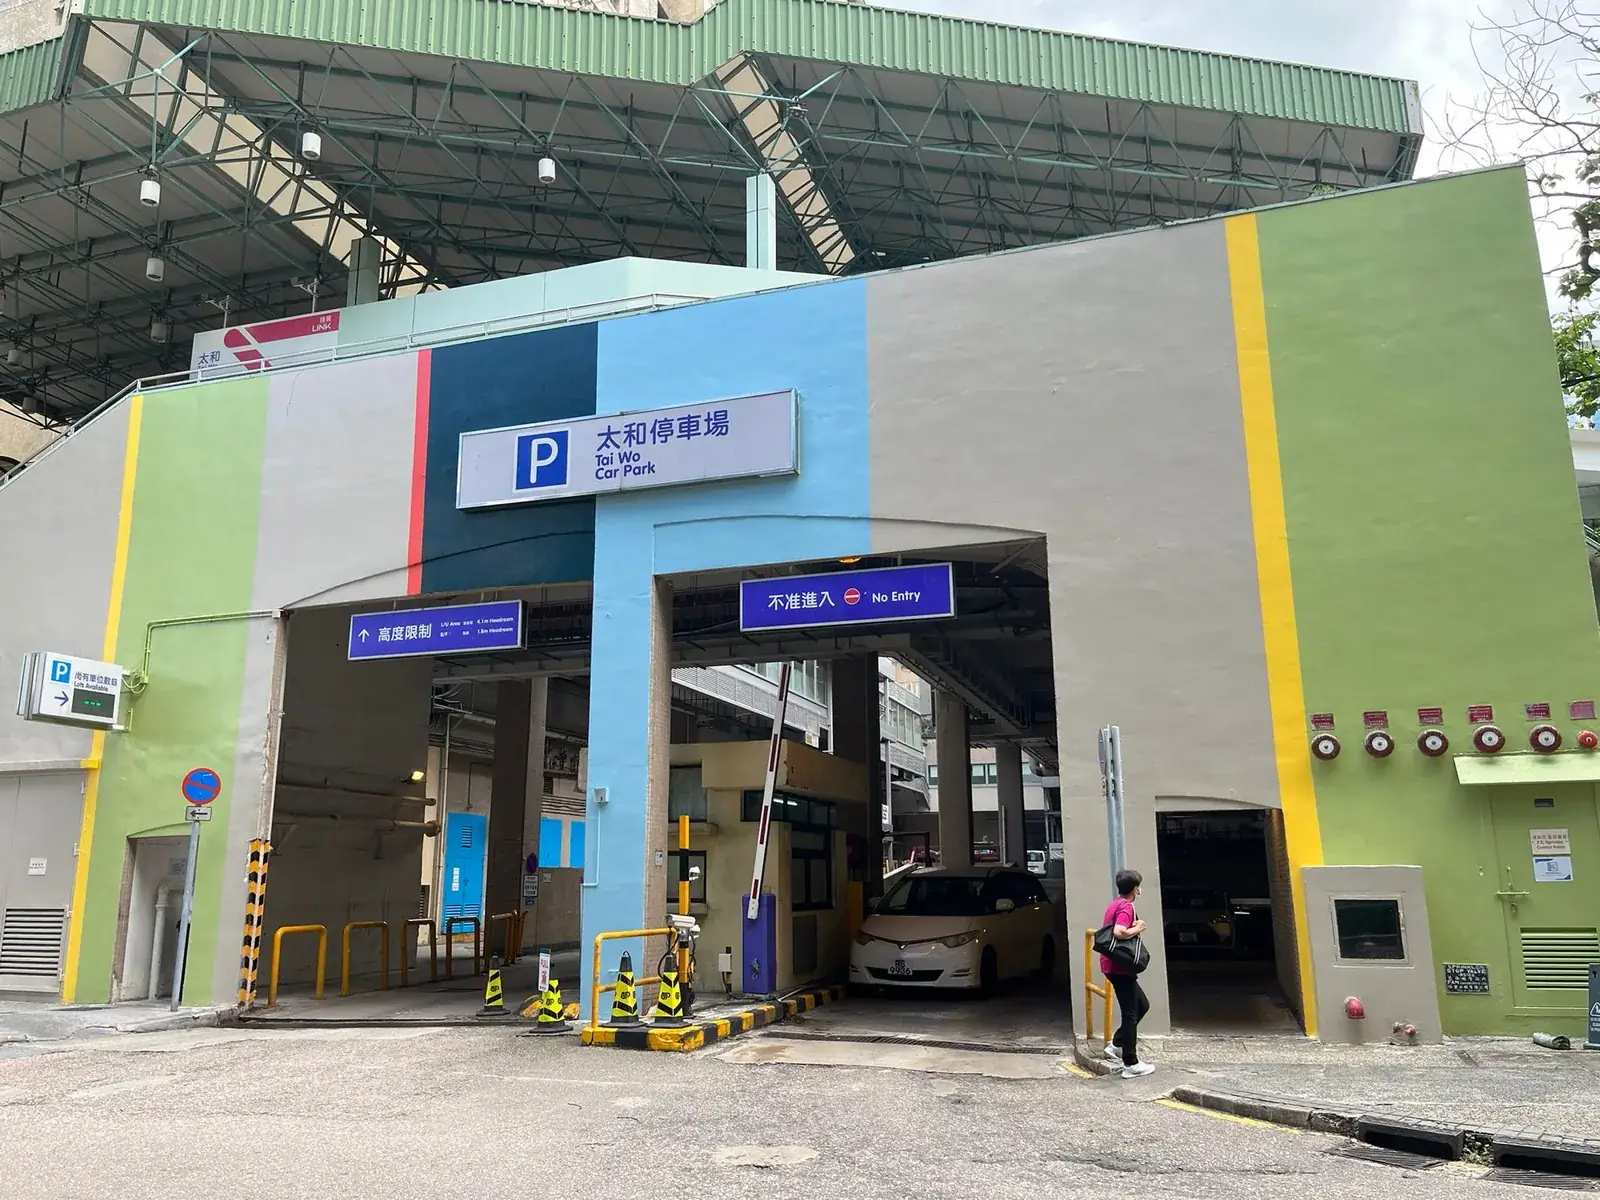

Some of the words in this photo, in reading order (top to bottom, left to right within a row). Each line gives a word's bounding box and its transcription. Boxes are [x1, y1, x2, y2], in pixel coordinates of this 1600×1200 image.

[312, 322, 332, 332] LINK
[198, 350, 221, 365] 太和
[596, 409, 730, 452] 太和停車場
[529, 437, 559, 484] P
[595, 453, 613, 467] Tai
[618, 450, 641, 464] Wo
[595, 467, 619, 480] Car
[623, 461, 656, 477] Park
[767, 591, 835, 611] 不准進入
[872, 592, 888, 604] No
[892, 590, 921, 603] Entry
[377, 623, 432, 642] 高度限制
[55, 663, 69, 680] P
[85, 683, 108, 691] Available
